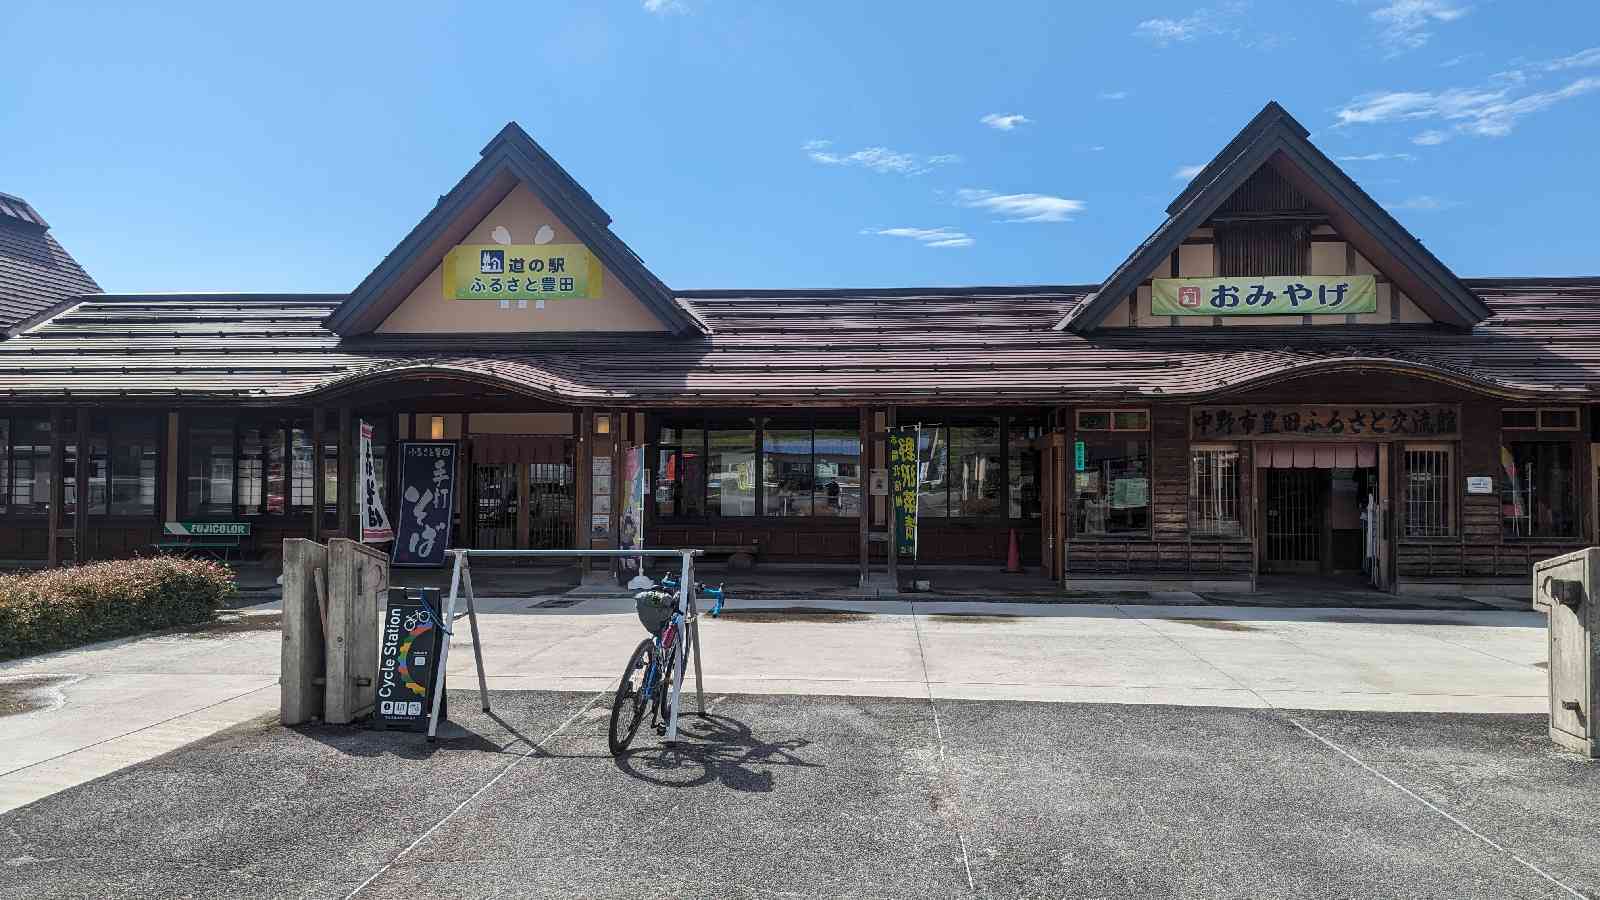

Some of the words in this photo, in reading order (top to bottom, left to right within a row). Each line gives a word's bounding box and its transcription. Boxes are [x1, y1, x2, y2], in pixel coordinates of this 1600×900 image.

[508, 257, 565, 273] 道の駅
[470, 277, 574, 292] ふるさと豊田
[1210, 284, 1349, 308] おみやげ
[191, 524, 245, 534] FUJICOLOR
[404, 485, 446, 558] そば
[384, 608, 401, 656] Station
[378, 658, 396, 698] Cycle
